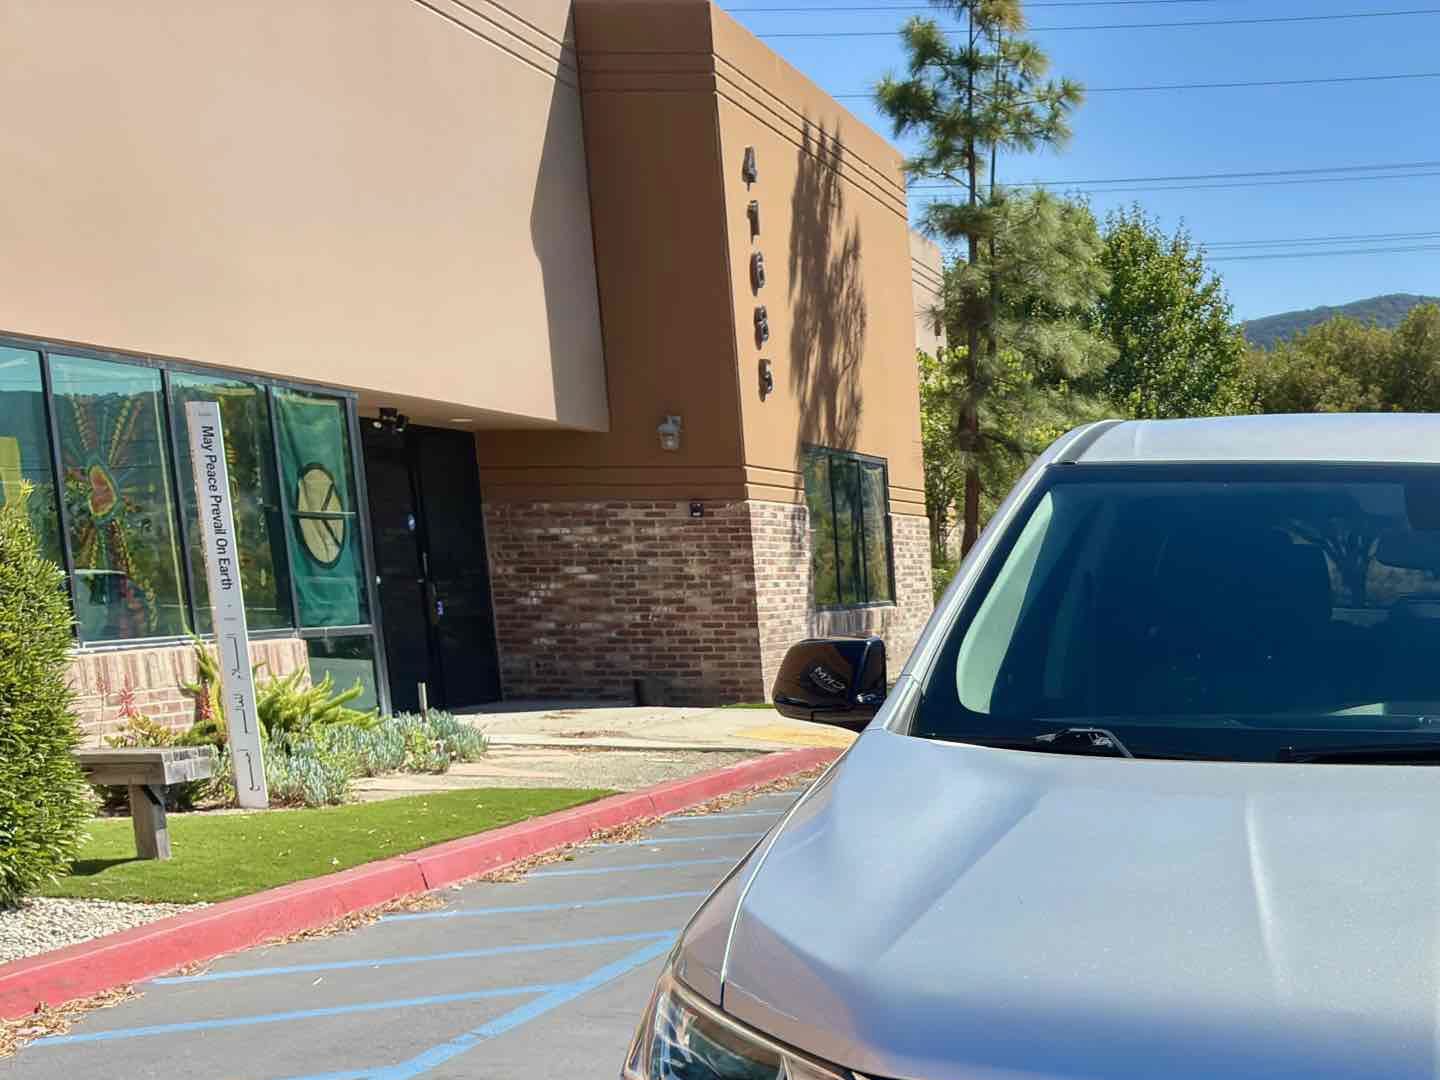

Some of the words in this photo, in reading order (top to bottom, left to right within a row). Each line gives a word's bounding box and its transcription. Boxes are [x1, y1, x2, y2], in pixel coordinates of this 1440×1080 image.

[201, 425, 214, 451] May
[205, 455, 218, 491] Peace
[210, 495, 226, 535] Prevail
[216, 538, 228, 554] On
[218, 558, 232, 590] Earth
